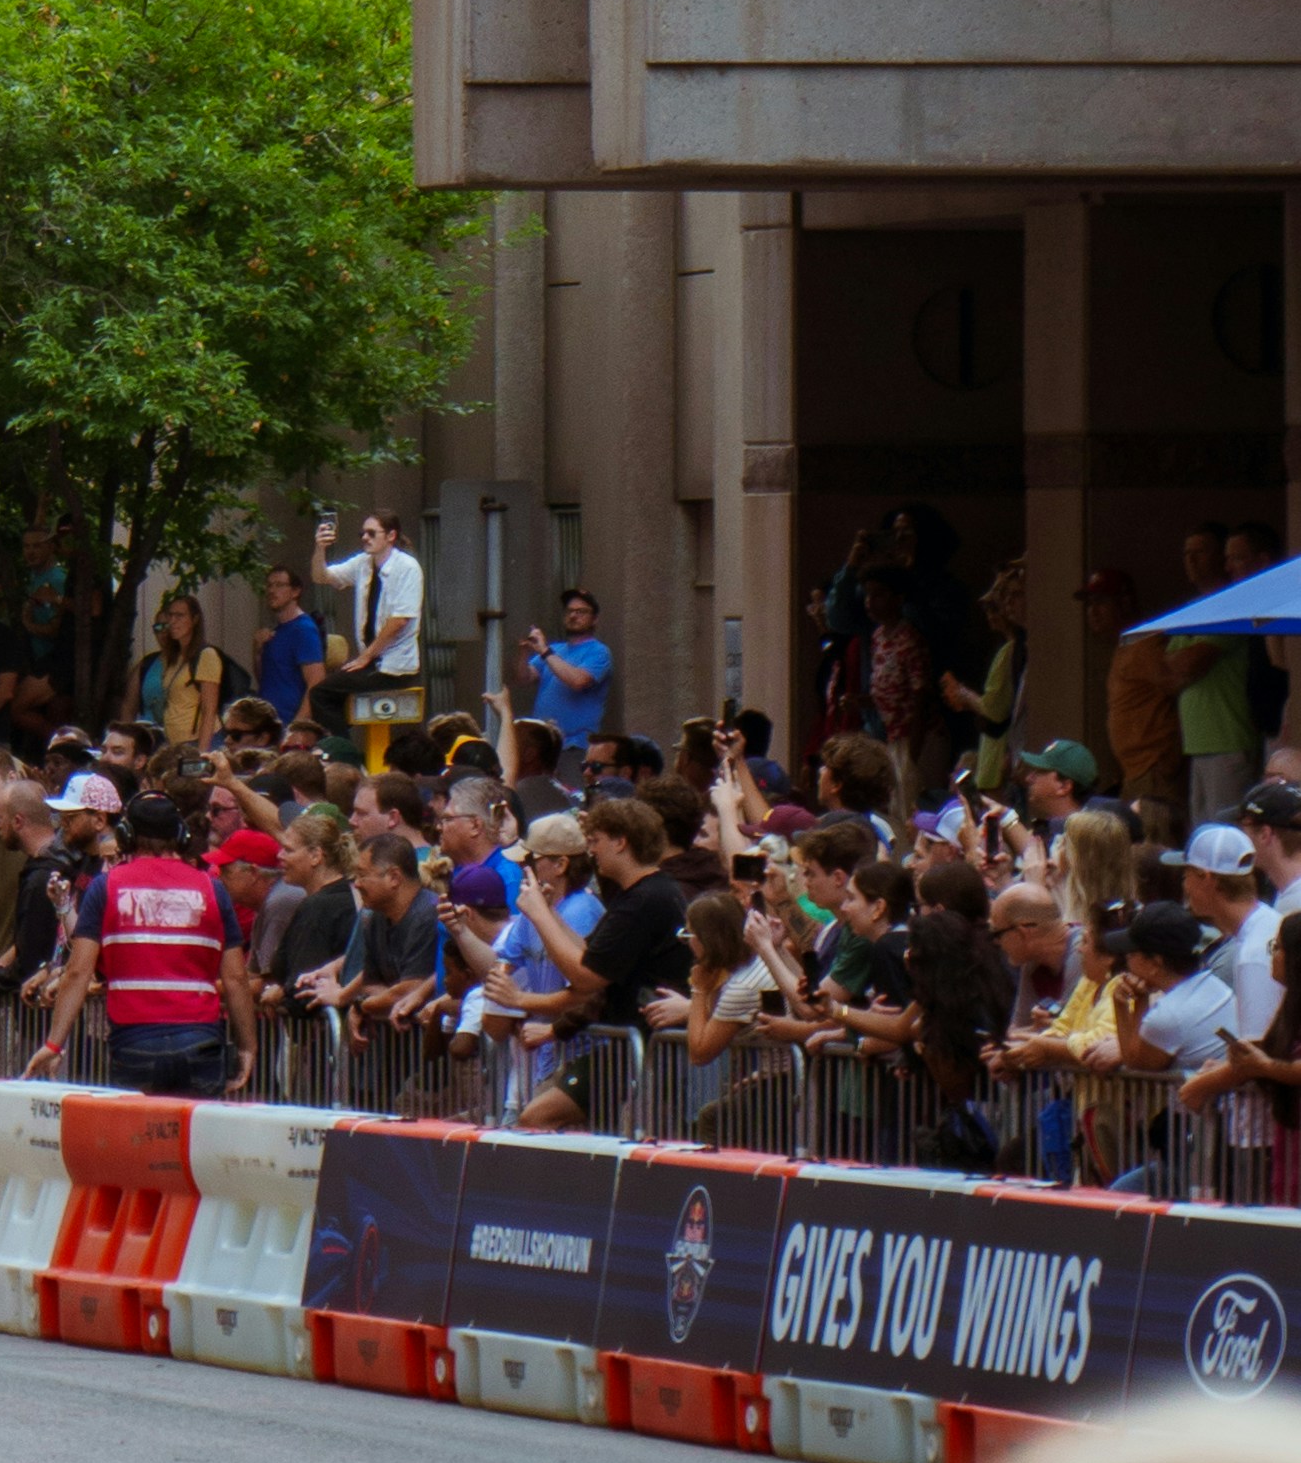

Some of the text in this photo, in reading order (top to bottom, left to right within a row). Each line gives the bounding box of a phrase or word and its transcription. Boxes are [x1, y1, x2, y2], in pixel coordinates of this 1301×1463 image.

[470, 1224, 593, 1273] #REDBULLSHOWRUN
[771, 1222, 1103, 1385] GIVES YOU WIIINGS
[1201, 1289, 1270, 1383] Ford
